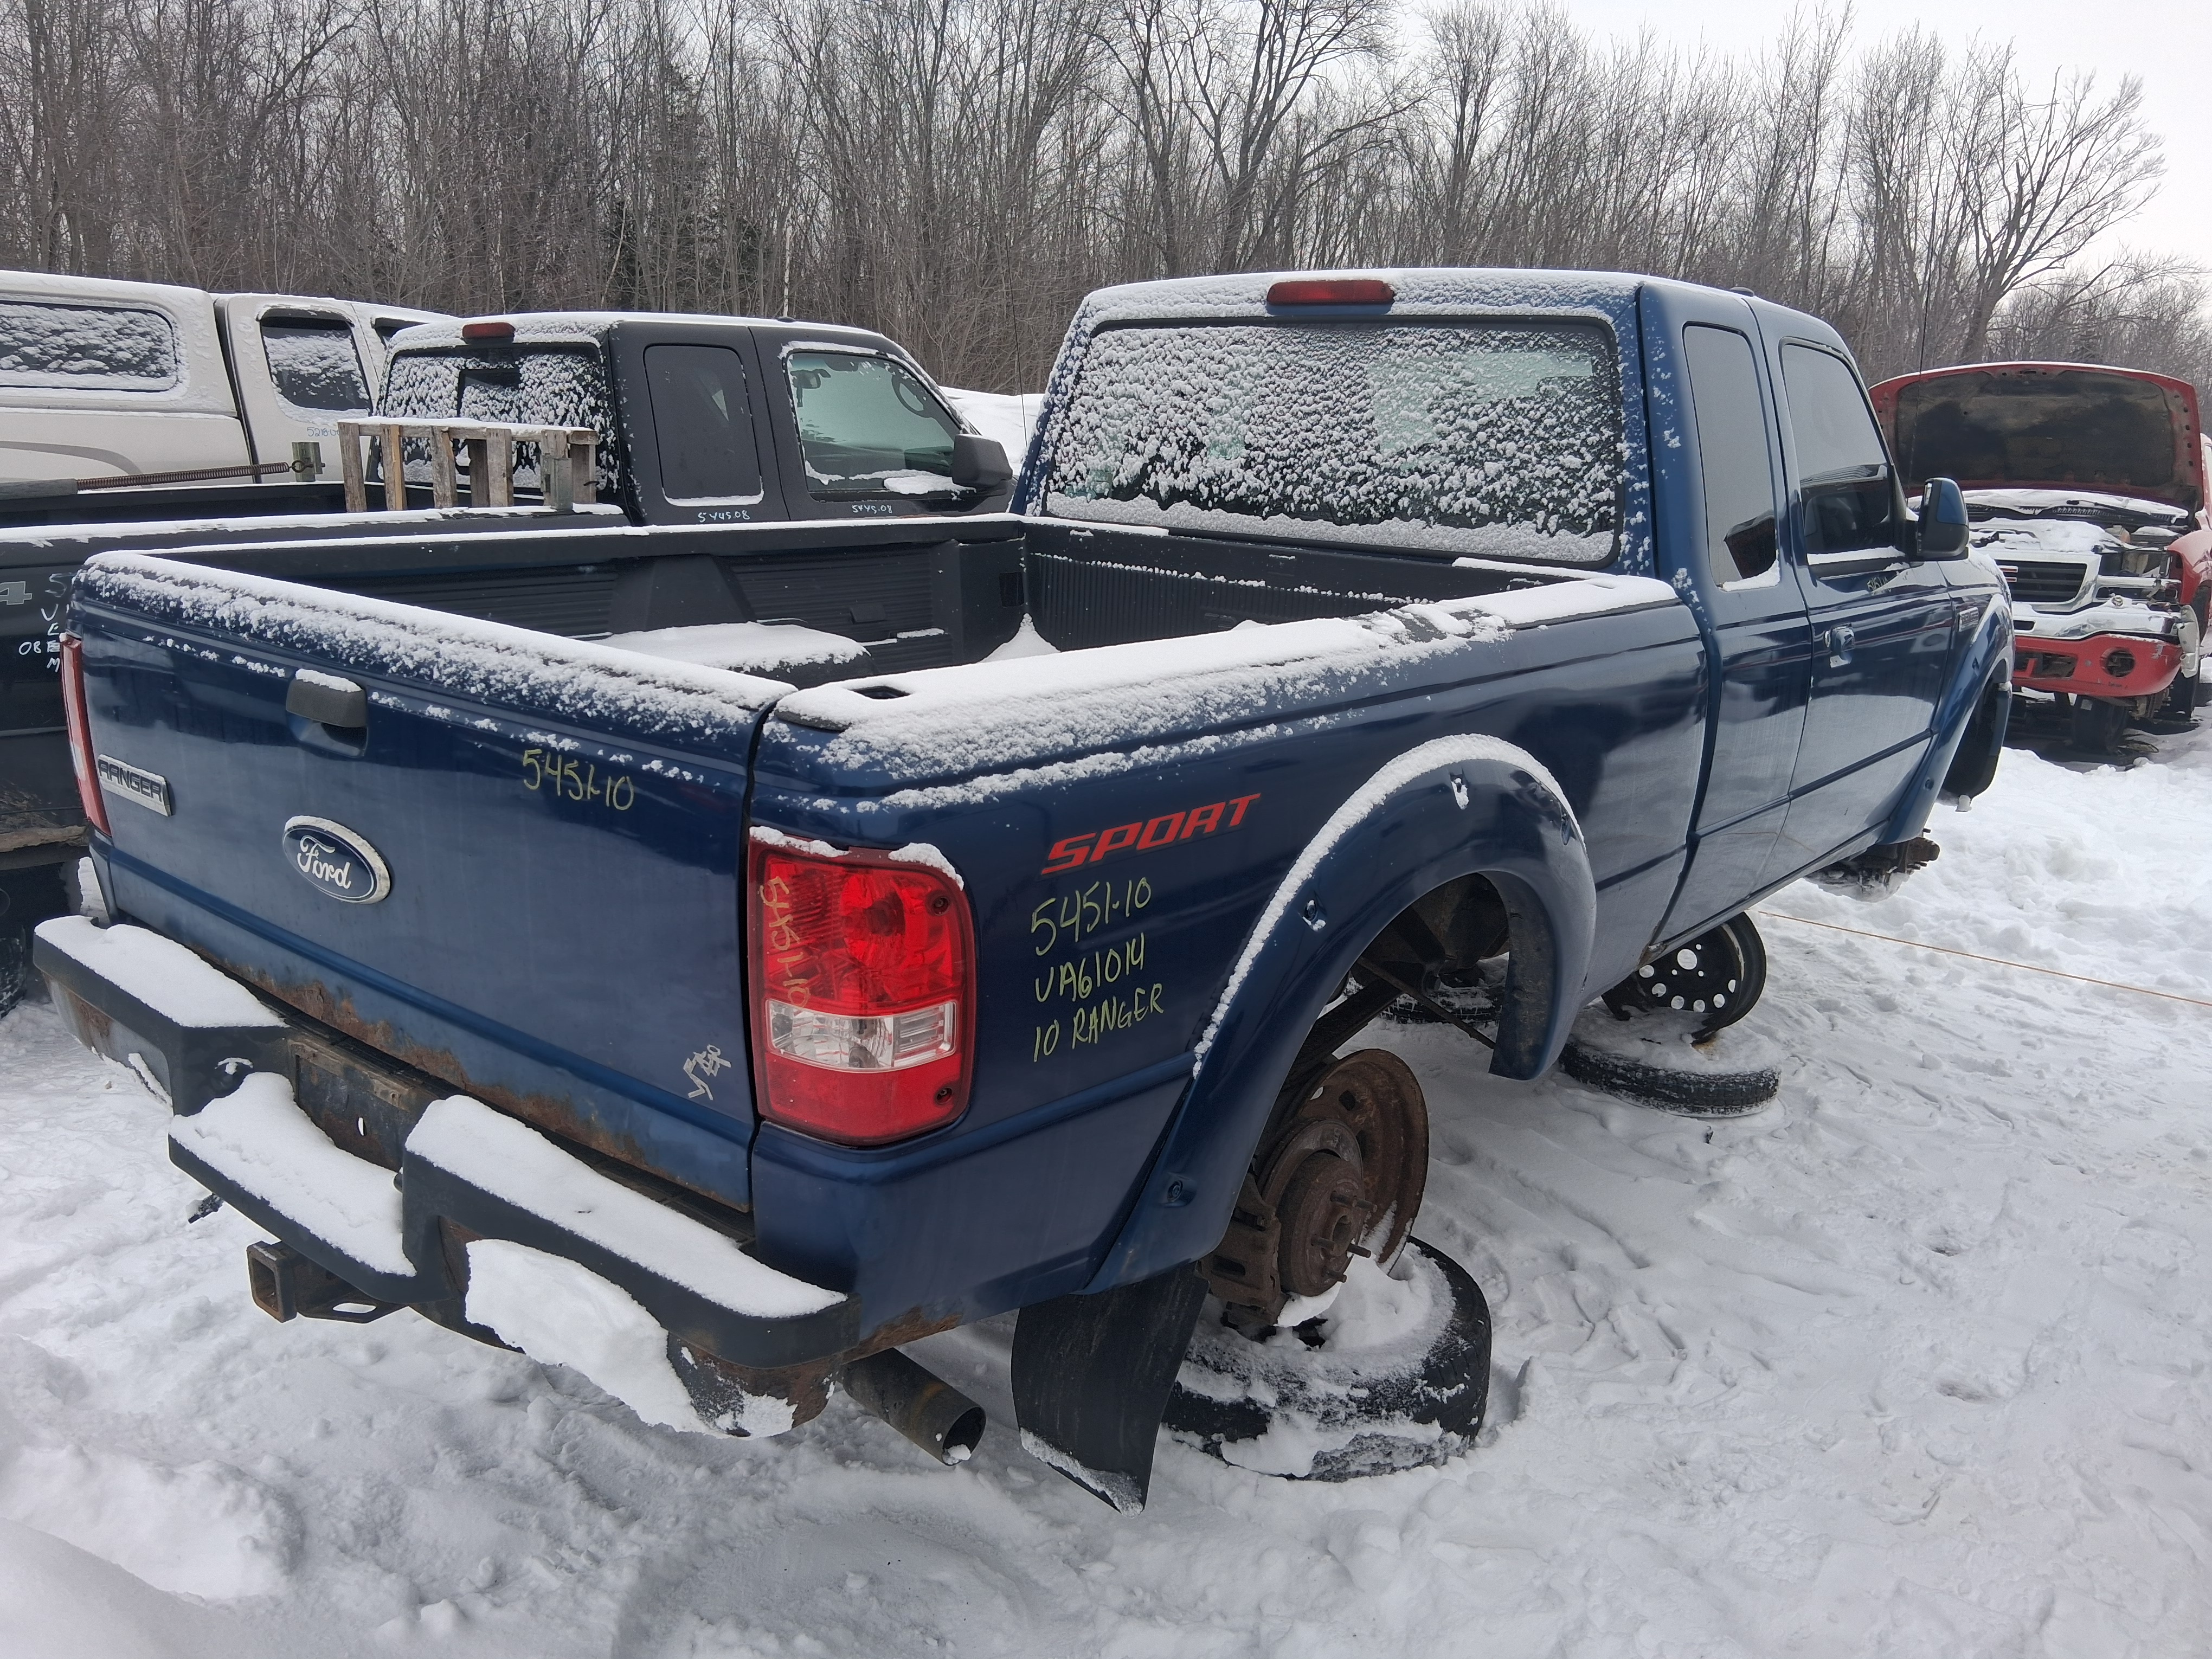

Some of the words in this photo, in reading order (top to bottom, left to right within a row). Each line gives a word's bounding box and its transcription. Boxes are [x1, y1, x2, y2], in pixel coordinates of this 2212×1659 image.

[98, 758, 162, 802] RANGER
[297, 835, 351, 889] Ford
[1041, 793, 1261, 875] SPORT
[1033, 1019, 1059, 1063] 10
[1072, 983, 1164, 1050] RANGER
